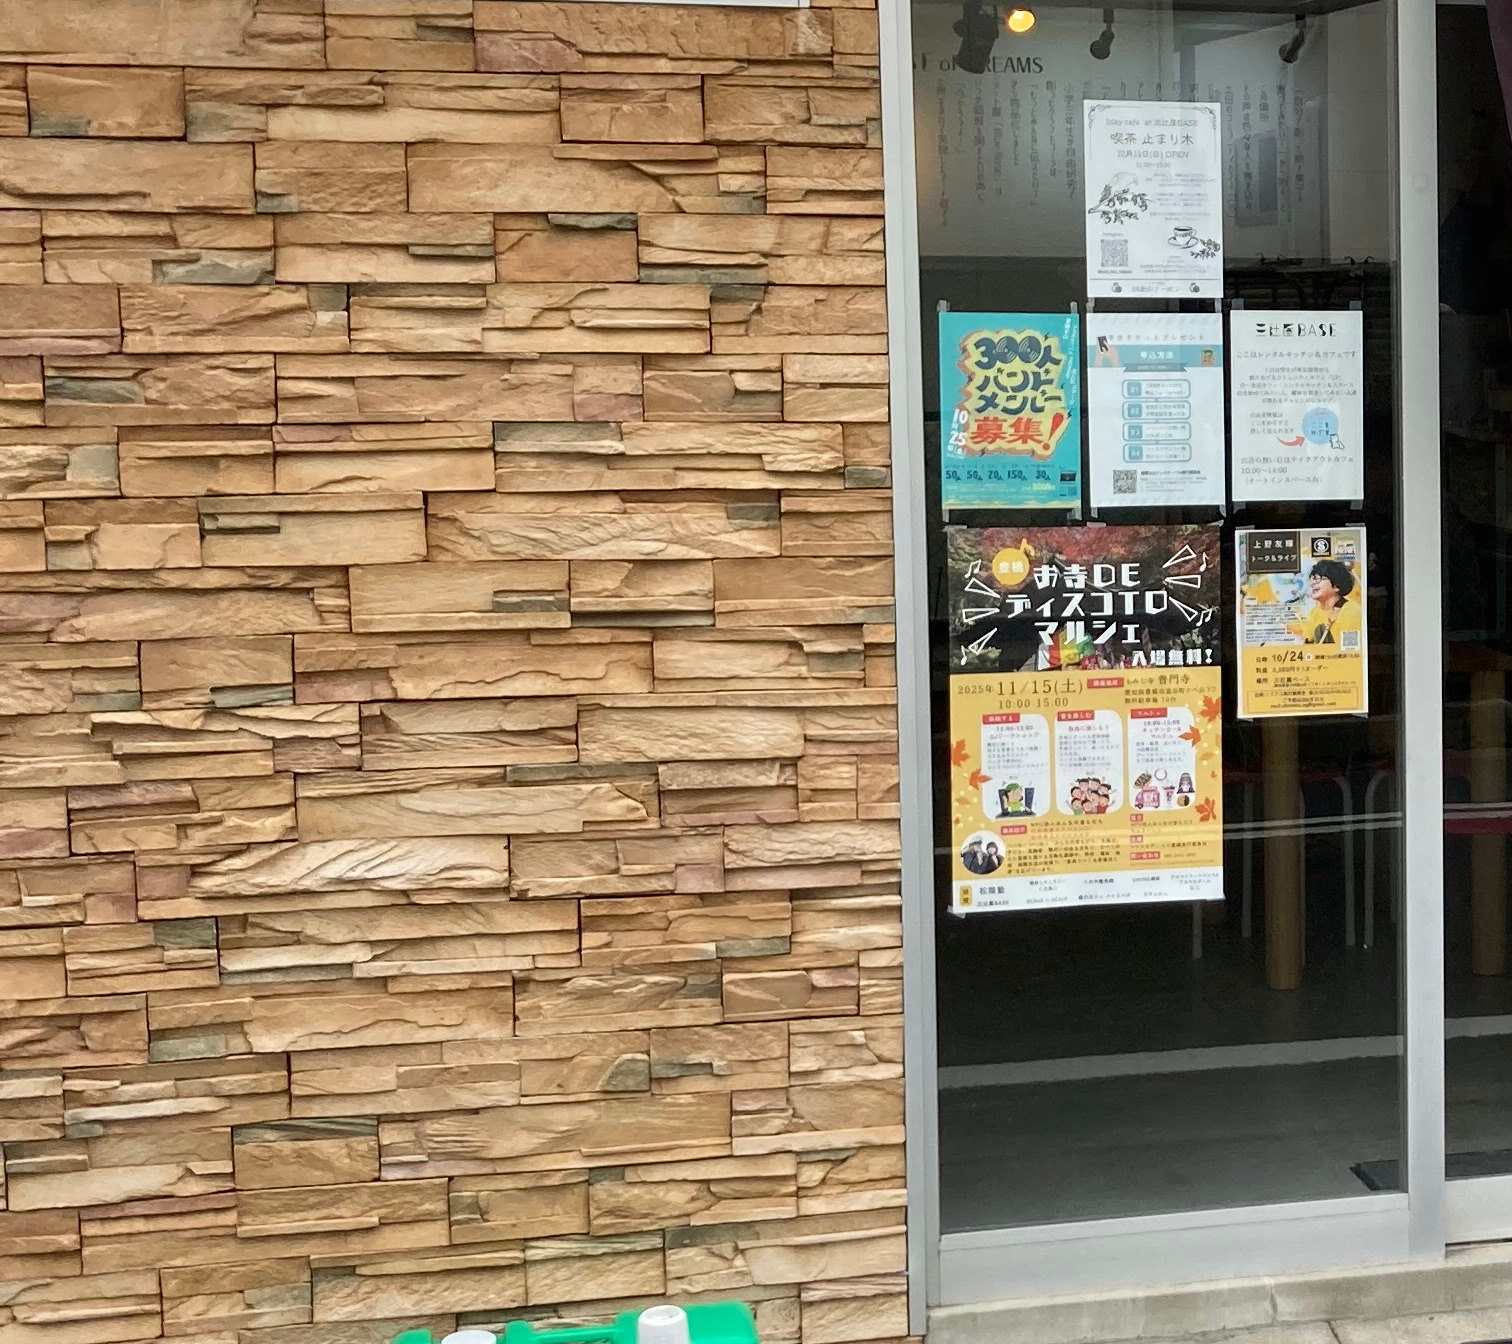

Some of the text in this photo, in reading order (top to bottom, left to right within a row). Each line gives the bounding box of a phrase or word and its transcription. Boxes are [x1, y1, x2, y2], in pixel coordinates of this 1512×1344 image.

[1111, 132, 1194, 146] 喫茶 止まり木
[1165, 150, 1189, 159] OPEN
[974, 335, 1062, 370] 300人
[976, 367, 1053, 393] バンド
[975, 389, 1062, 415] メンバー
[1251, 553, 1298, 563] トーク&ライブ
[1033, 563, 1140, 589] お寺DE
[1034, 620, 1141, 646] マルシェ
[1271, 649, 1304, 664] 10/24
[998, 677, 1083, 696] 11/15(土)
